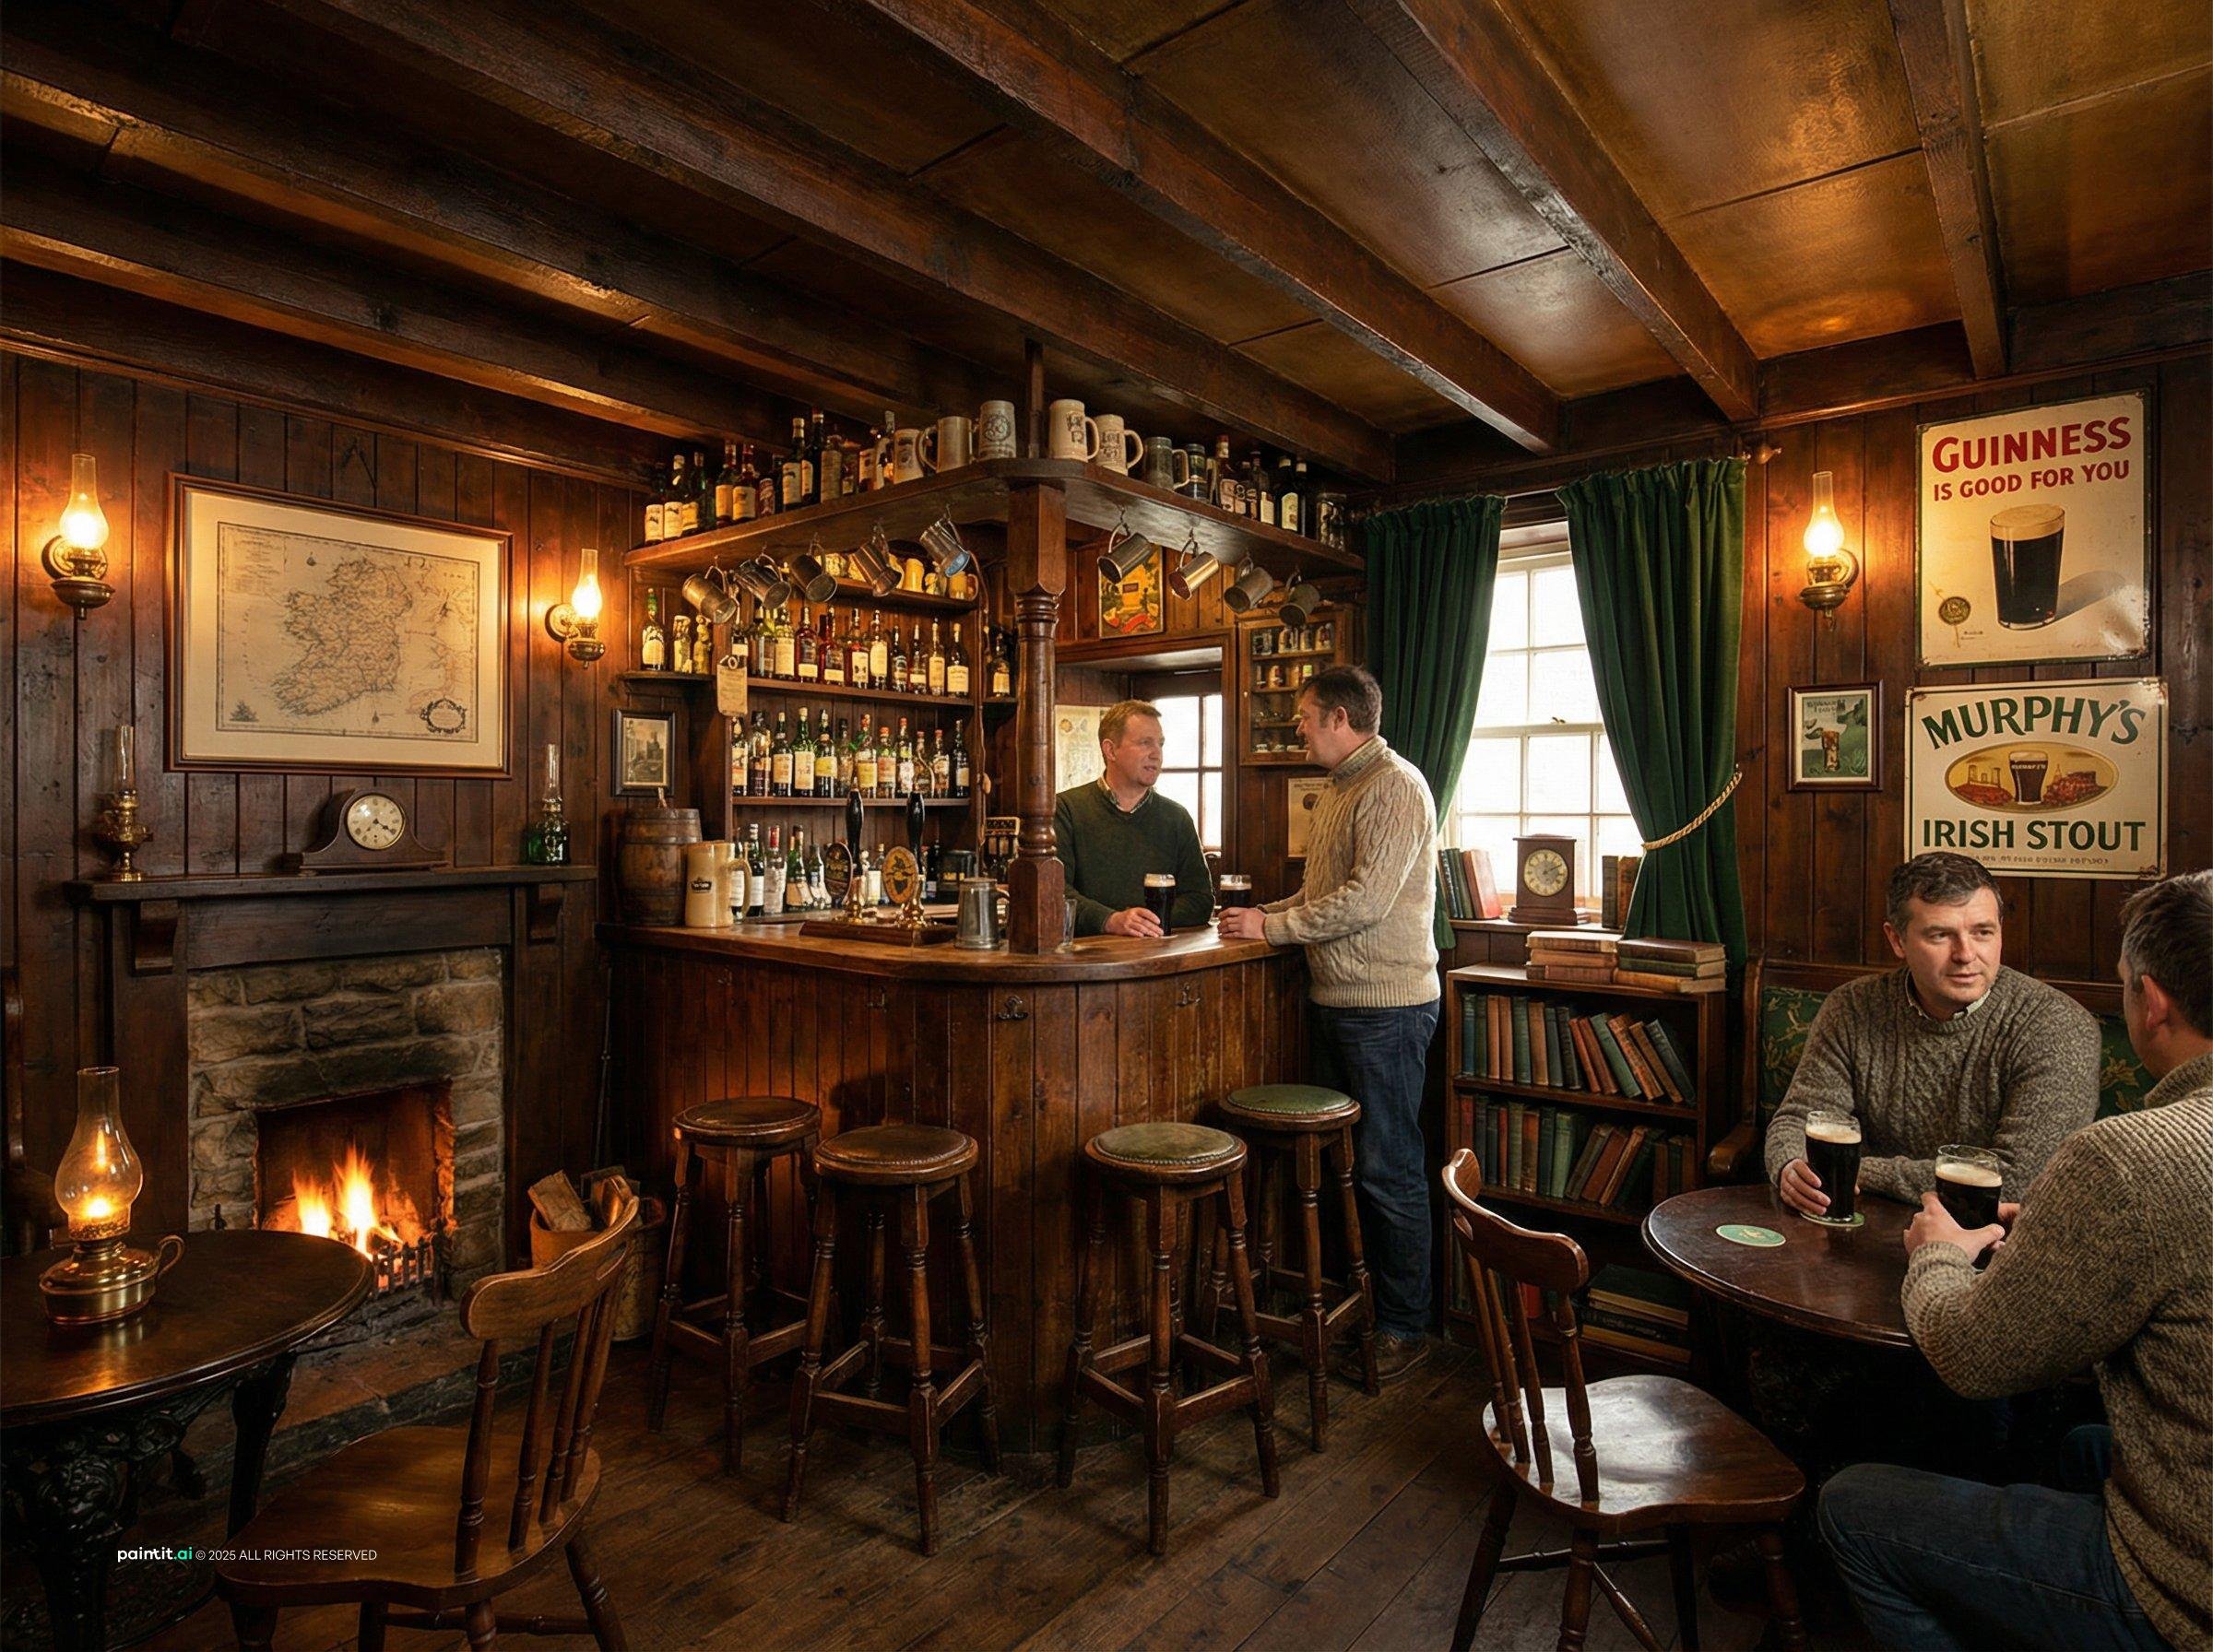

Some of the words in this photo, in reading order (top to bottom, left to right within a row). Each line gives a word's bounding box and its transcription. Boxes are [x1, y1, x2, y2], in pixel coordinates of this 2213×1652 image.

[1932, 417, 2132, 473] GUINNESS
[1934, 482, 1953, 502] IS
[1959, 474, 2022, 499] GOOD
[2030, 466, 2075, 490] FOR
[2080, 459, 2129, 483] YOU
[1921, 695, 2147, 750] MURPHY'S
[1923, 819, 2015, 848] IRISH
[2026, 820, 2147, 851] STOUT
